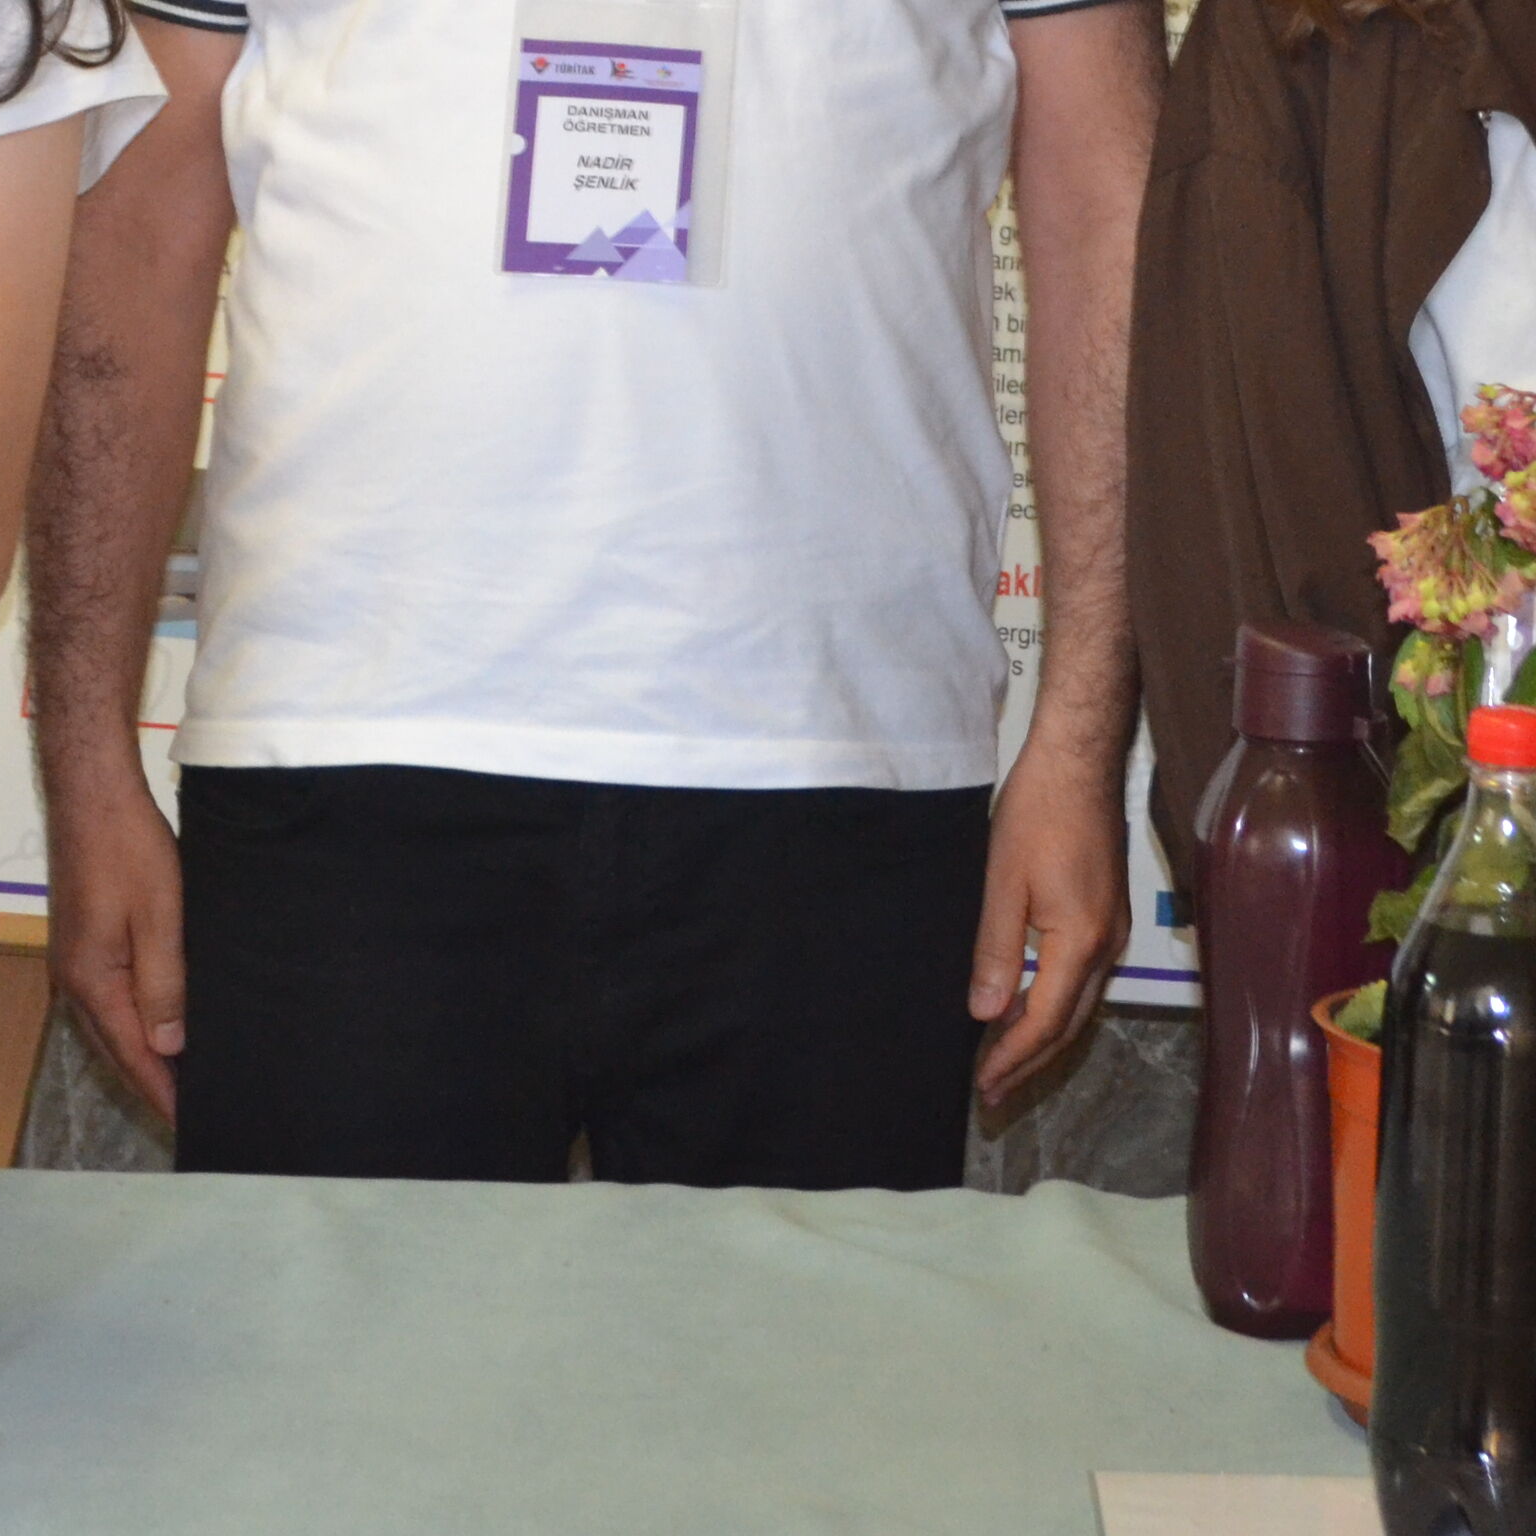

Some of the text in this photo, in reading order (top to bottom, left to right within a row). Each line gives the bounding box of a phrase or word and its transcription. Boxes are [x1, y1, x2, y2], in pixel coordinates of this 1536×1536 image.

[567, 105, 649, 121] DANIŞMAN
[563, 120, 651, 137] ÖĞRETMEN
[577, 154, 633, 171] NADİR
[573, 174, 638, 191] ŞENLİK
